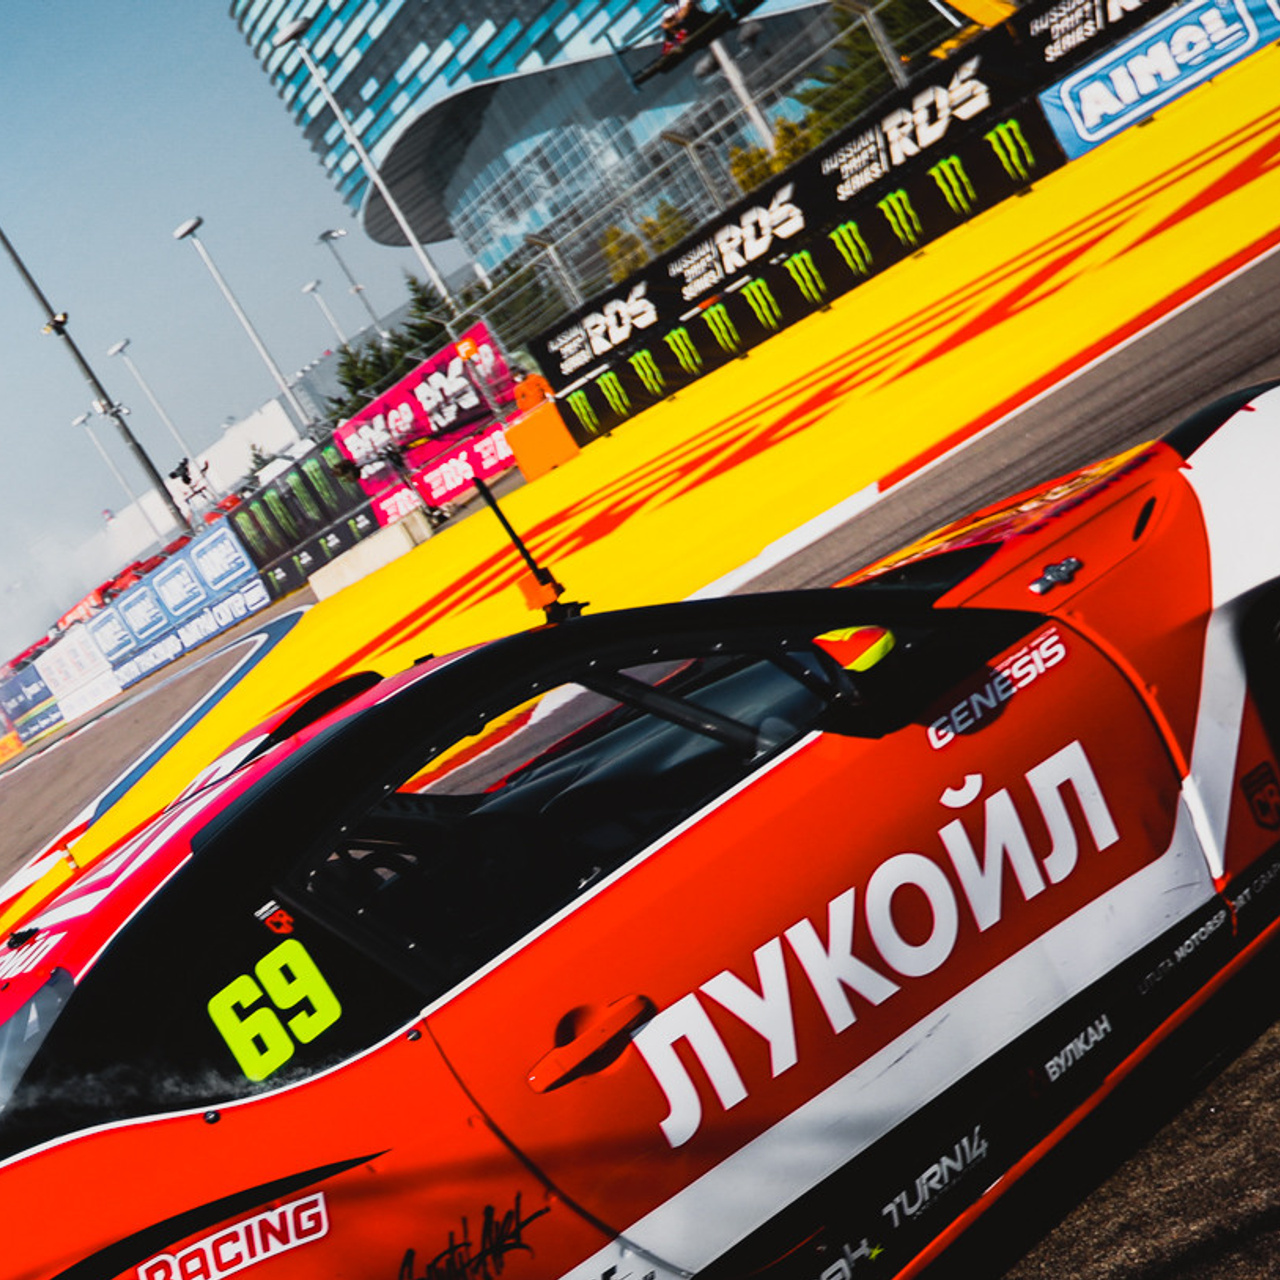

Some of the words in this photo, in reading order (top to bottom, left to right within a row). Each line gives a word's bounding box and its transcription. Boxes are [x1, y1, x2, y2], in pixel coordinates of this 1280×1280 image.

[881, 55, 991, 166] RDS
[1078, 7, 1246, 129] AIMOL
[821, 129, 876, 175] RUSSIAN
[836, 161, 884, 201] SERIES
[714, 182, 805, 274] RDS
[581, 281, 658, 356] RDS
[926, 634, 1067, 750] GENESIS
[631, 740, 1120, 1149] ЛУКОЙЛ
[207, 938, 342, 1082] 69
[881, 1124, 989, 1228] TURN14
